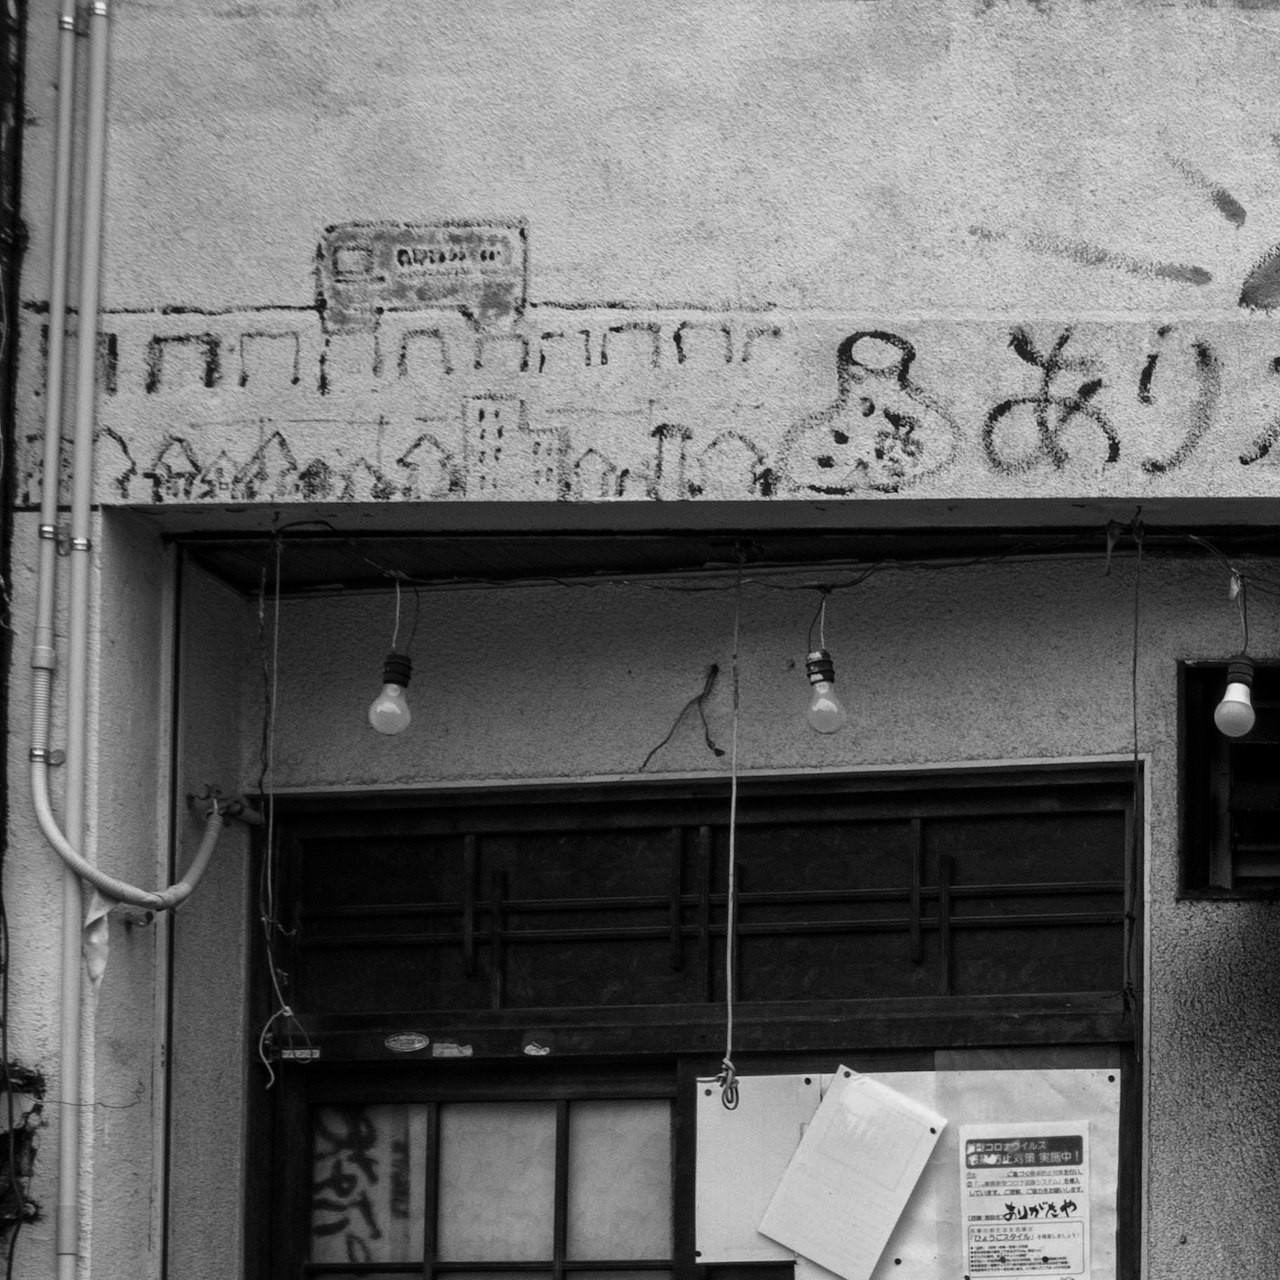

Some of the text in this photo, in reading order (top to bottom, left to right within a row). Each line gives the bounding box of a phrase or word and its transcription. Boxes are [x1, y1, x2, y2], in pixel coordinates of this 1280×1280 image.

[1002, 1200, 1078, 1221] ありがたや
